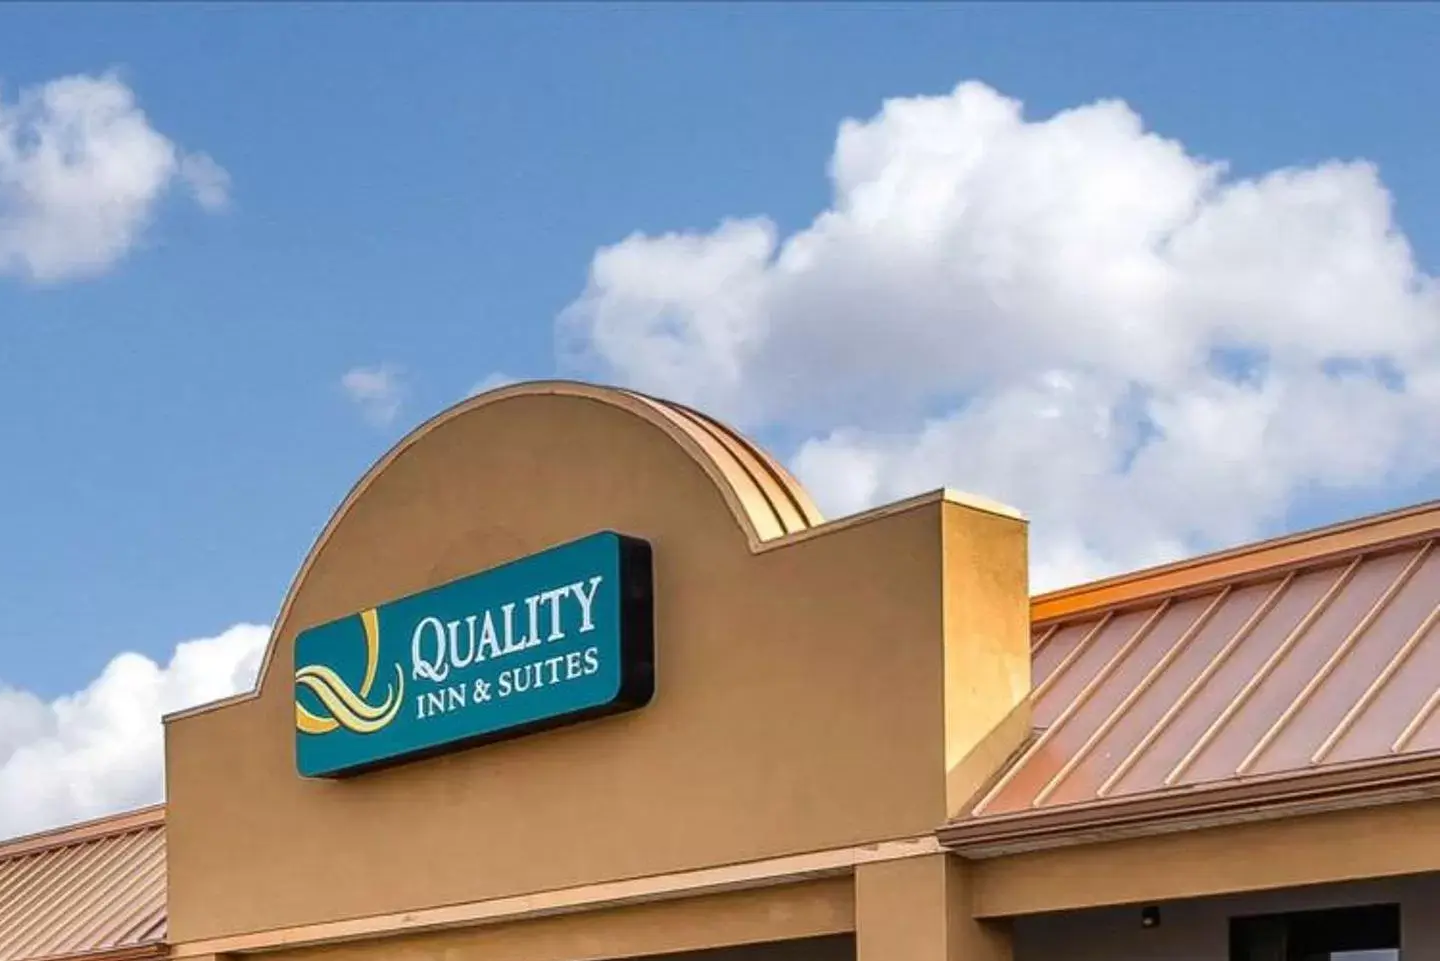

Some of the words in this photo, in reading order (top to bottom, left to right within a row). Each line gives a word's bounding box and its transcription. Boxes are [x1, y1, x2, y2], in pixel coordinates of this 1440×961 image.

[411, 576, 603, 682] QUALITY
[417, 683, 466, 719] INN
[473, 680, 492, 704] &
[499, 647, 599, 694] SUITES
